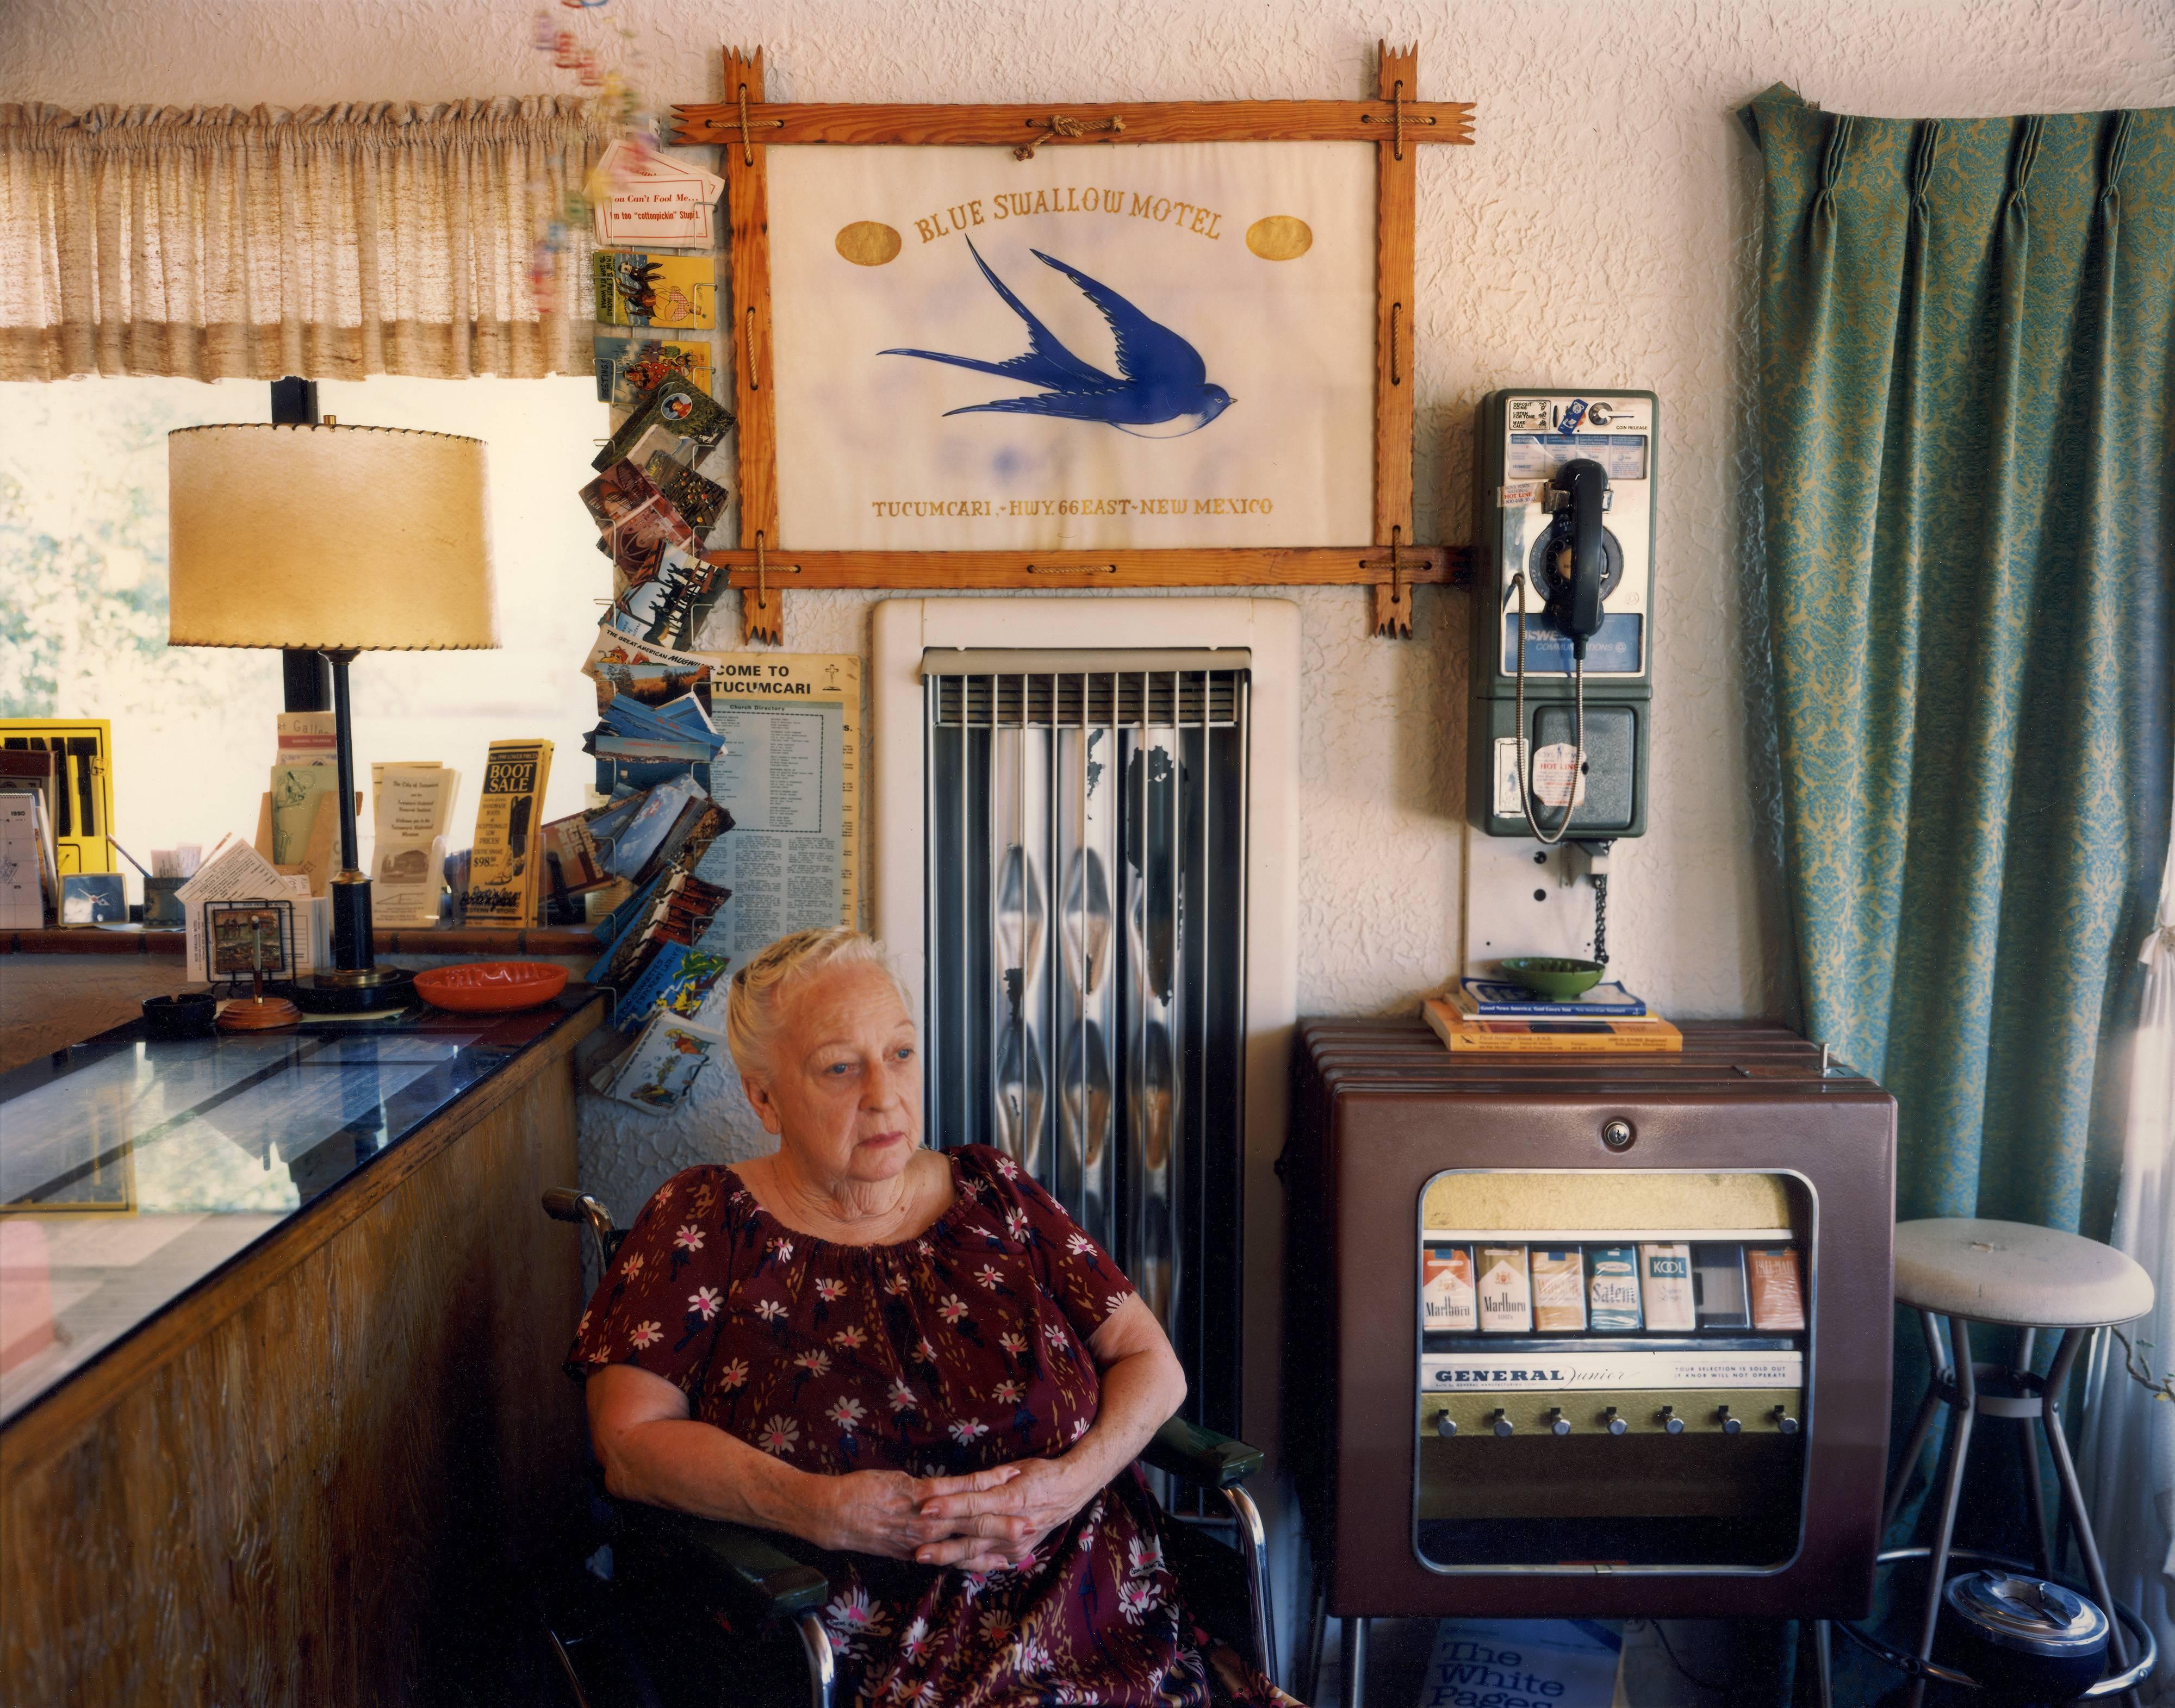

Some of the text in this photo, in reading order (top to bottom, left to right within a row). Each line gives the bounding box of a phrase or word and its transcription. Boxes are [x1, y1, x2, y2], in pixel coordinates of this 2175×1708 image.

[612, 195, 624, 203] ou
[654, 194, 672, 202] Fool
[610, 211, 619, 220] Im
[913, 187, 1222, 243] BLUE SWALLOW MOTEL
[1058, 500, 1079, 516] 66
[1081, 500, 1131, 516] EAST
[1140, 499, 1187, 515] NEW
[1194, 498, 1273, 515] MEXICO
[606, 629, 618, 638] THE
[618, 635, 638, 648] GREAT
[637, 644, 668, 659] AMERICAN
[768, 666, 789, 676] TO
[714, 681, 811, 694] TUCUMCARI
[490, 764, 533, 778] BOOT
[489, 778, 529, 792] SALE
[474, 856, 489, 868] $98
[1654, 1261, 1685, 1274] KOOL
[1755, 1260, 1794, 1275] PALL MALL
[1592, 1282, 1636, 1304] Salem
[1426, 1296, 1470, 1317] Marlboro
[1484, 1292, 1526, 1313] Marlboro
[1435, 1365, 1625, 1389] GENERAL Junior
[1441, 1641, 1522, 1668] The
[1435, 1662, 1566, 1699] White
